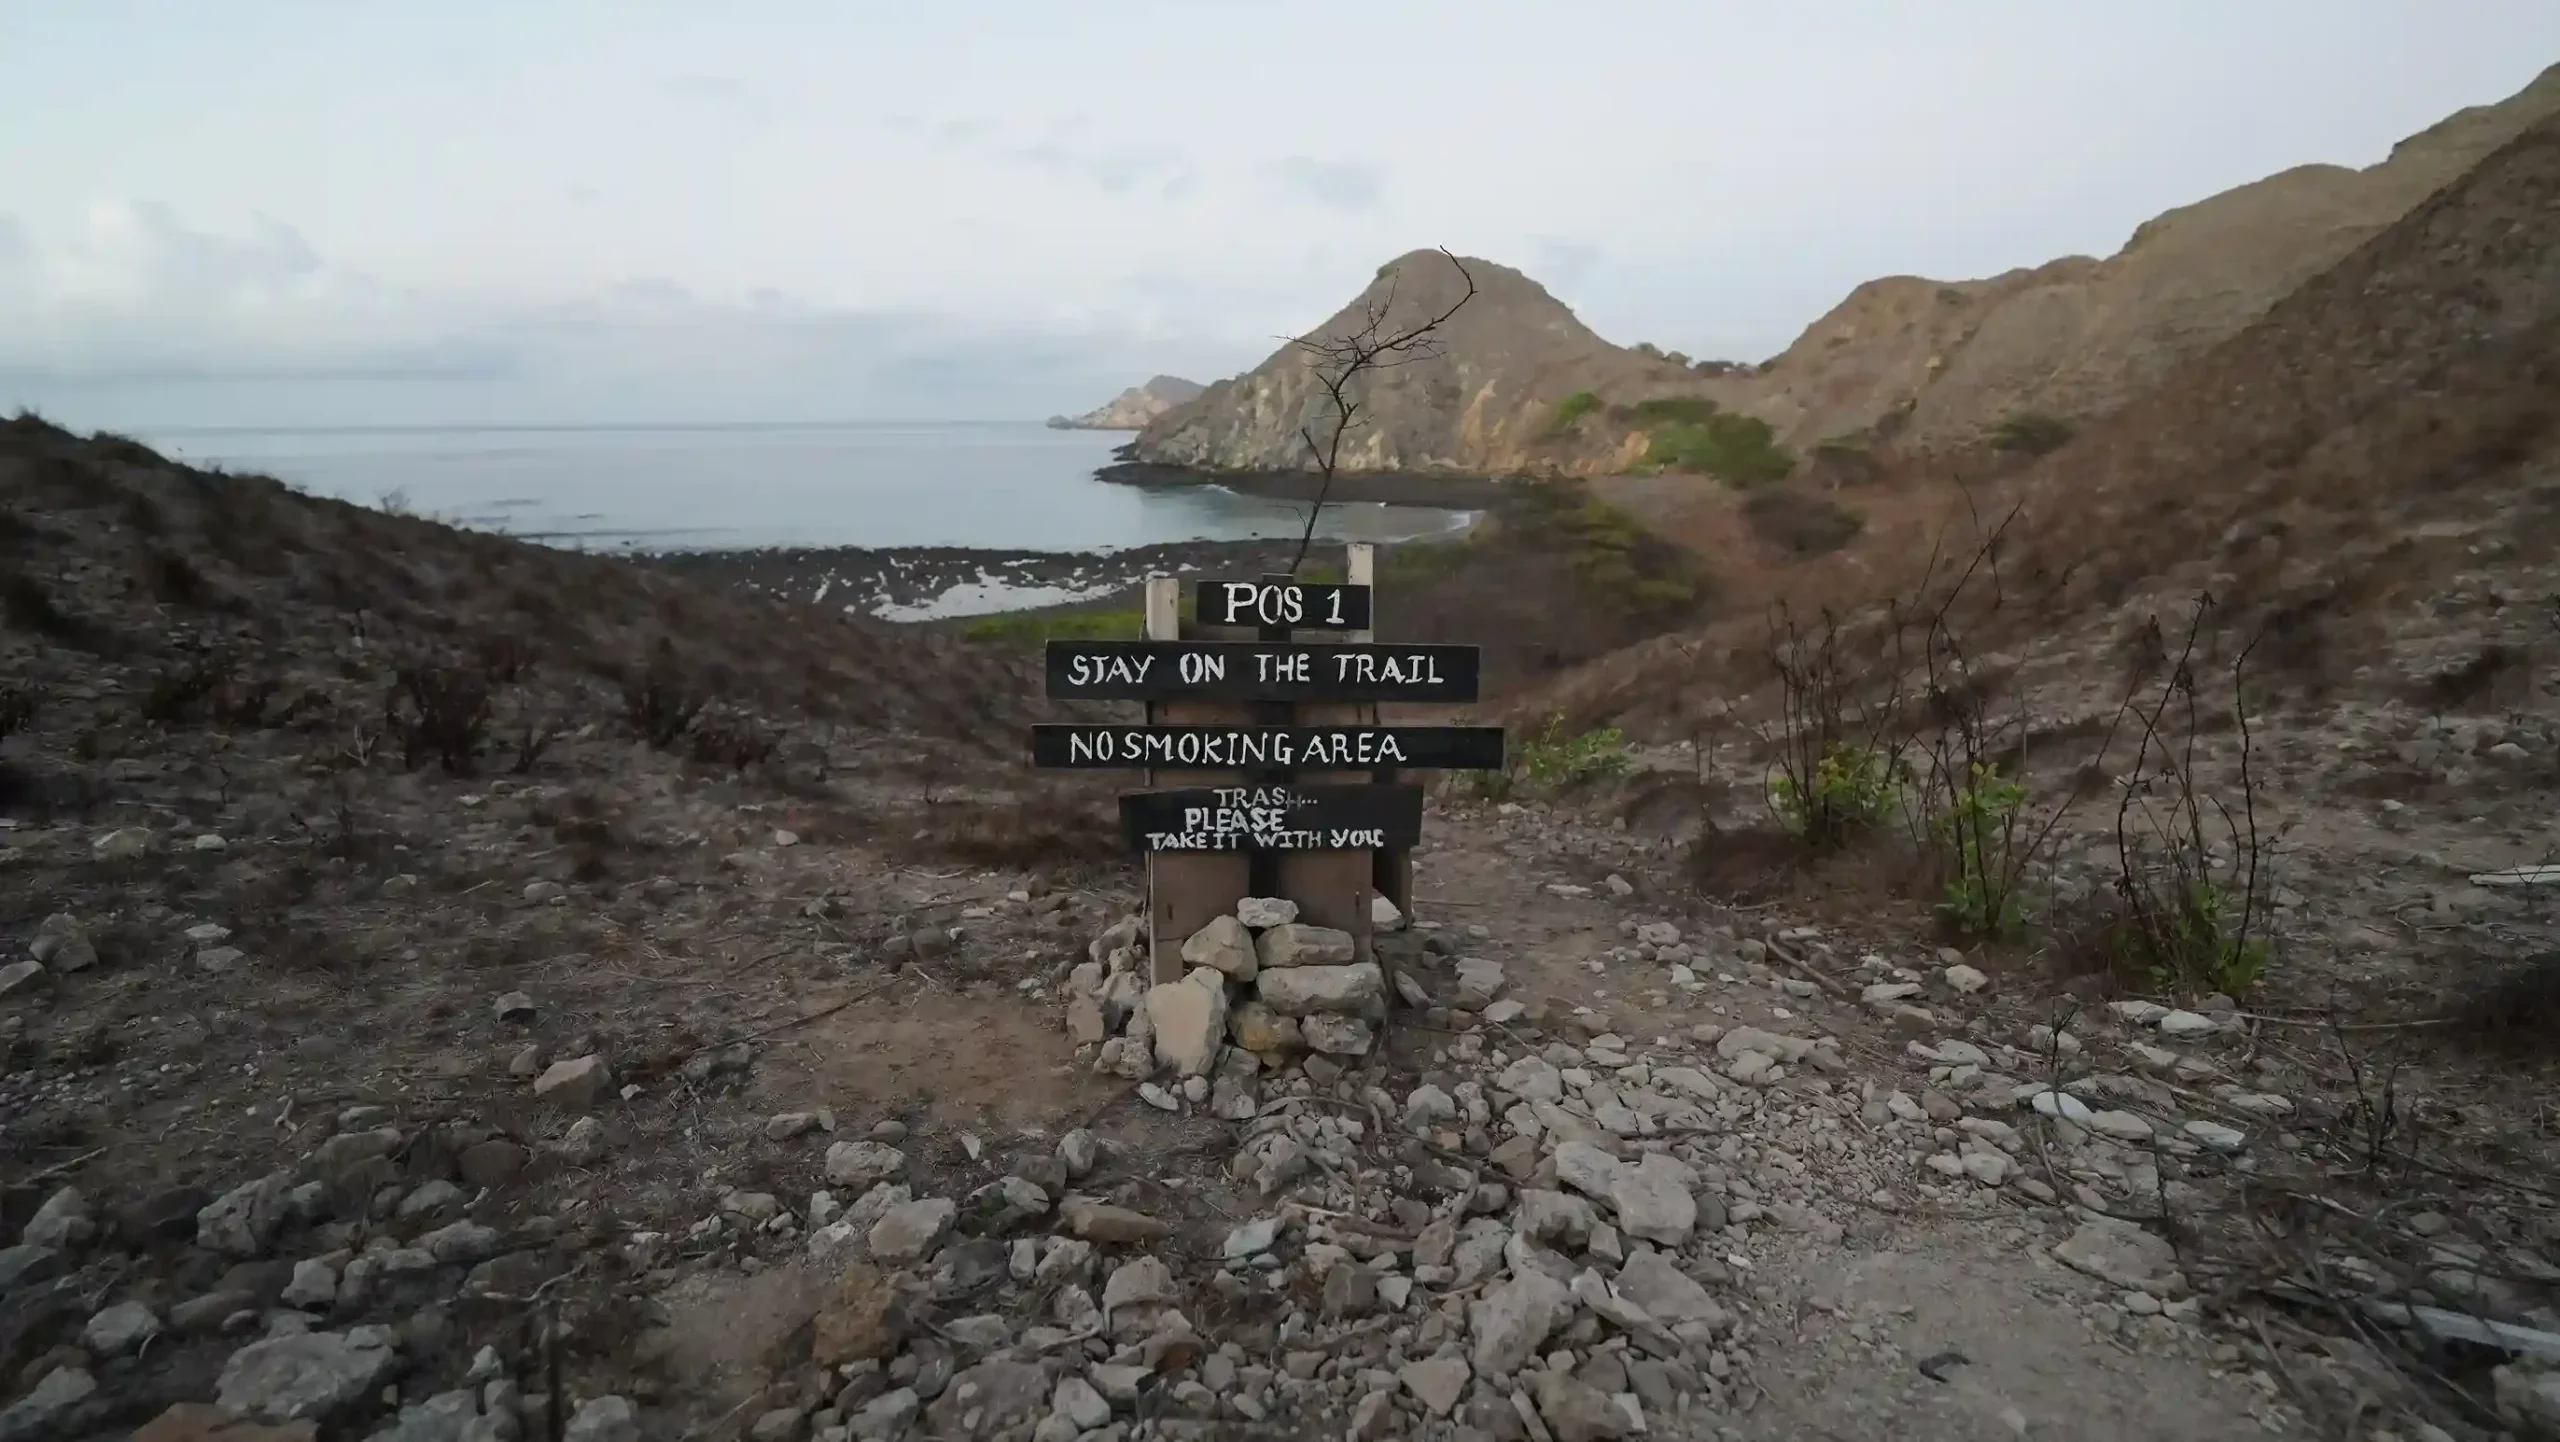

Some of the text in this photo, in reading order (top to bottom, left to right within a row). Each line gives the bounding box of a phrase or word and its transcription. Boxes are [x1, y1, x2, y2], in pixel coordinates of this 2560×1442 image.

[1223, 582, 1345, 625] POS 1
[1067, 653, 1445, 686] STAY ON THE TRAIL
[1070, 731, 1407, 765] NO SMOKING AREA
[1185, 807, 1286, 833] PLEASE
[1145, 832, 1207, 851] TAKE
[1213, 832, 1243, 850] IT
[1253, 830, 1322, 849] WITH
